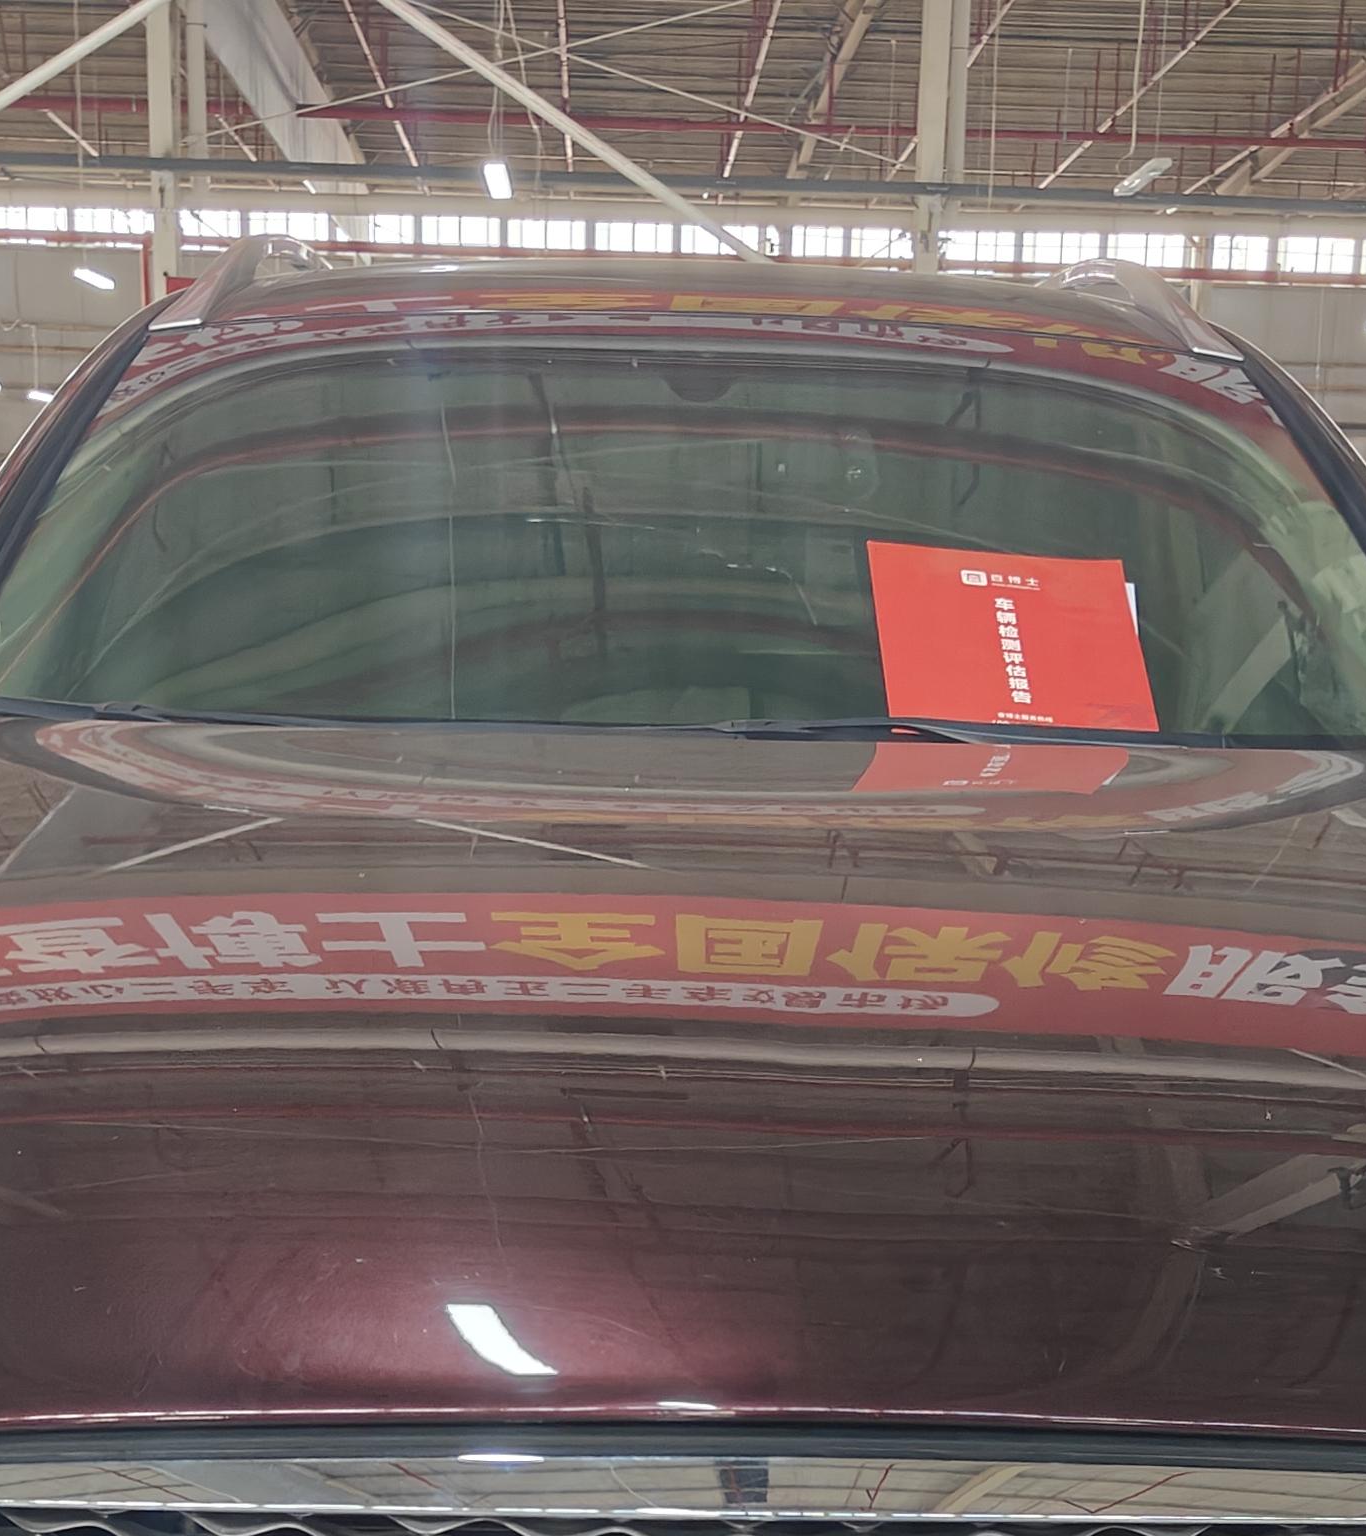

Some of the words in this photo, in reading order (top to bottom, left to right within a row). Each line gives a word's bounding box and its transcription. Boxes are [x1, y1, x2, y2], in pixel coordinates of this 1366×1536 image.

[994, 597, 1032, 704] 车辆检测评估报告
